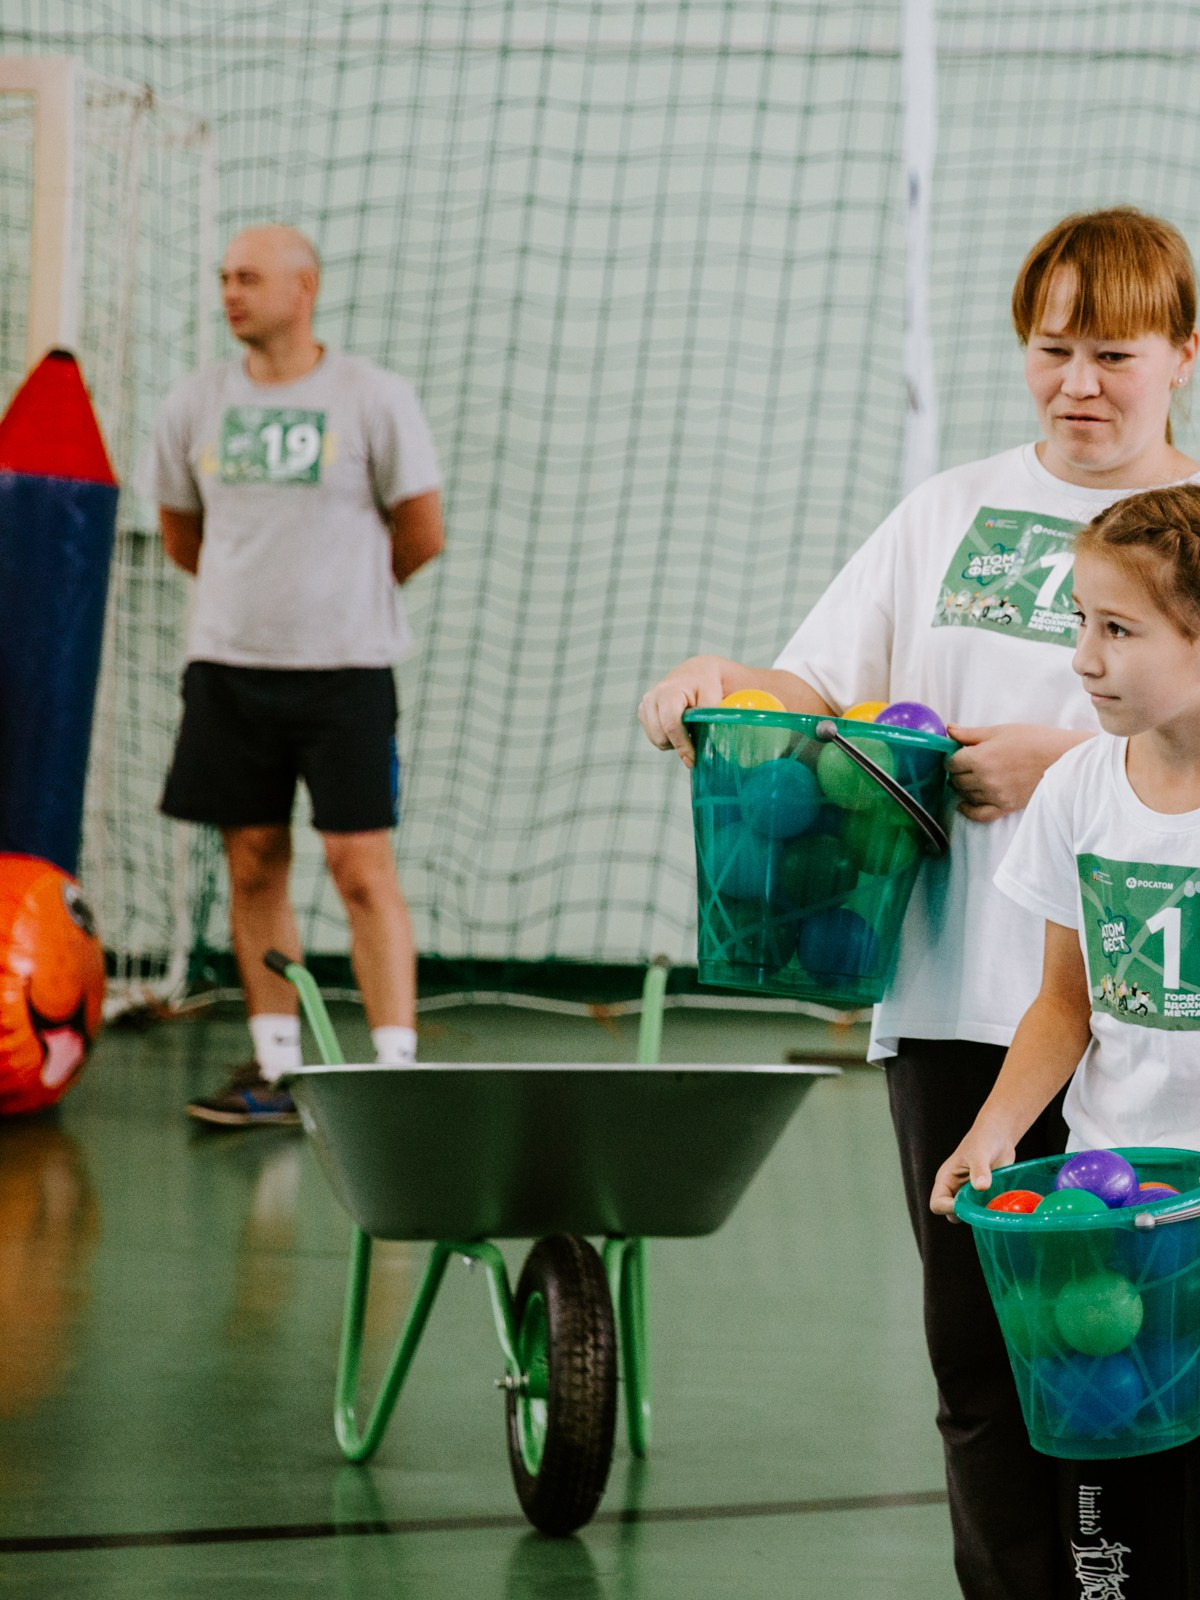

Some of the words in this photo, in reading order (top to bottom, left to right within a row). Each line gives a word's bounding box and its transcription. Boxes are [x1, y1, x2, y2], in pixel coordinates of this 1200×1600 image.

[260, 422, 320, 471] 19
[970, 553, 1015, 566] АТОМ
[968, 563, 1012, 577] ФЕСТ
[1034, 551, 1076, 608] 1
[1137, 879, 1174, 890] РОСАТОМ
[1101, 921, 1125, 939] АТОМ
[1103, 935, 1126, 953] ФЕСТ
[1078, 1484, 1103, 1535] limited
